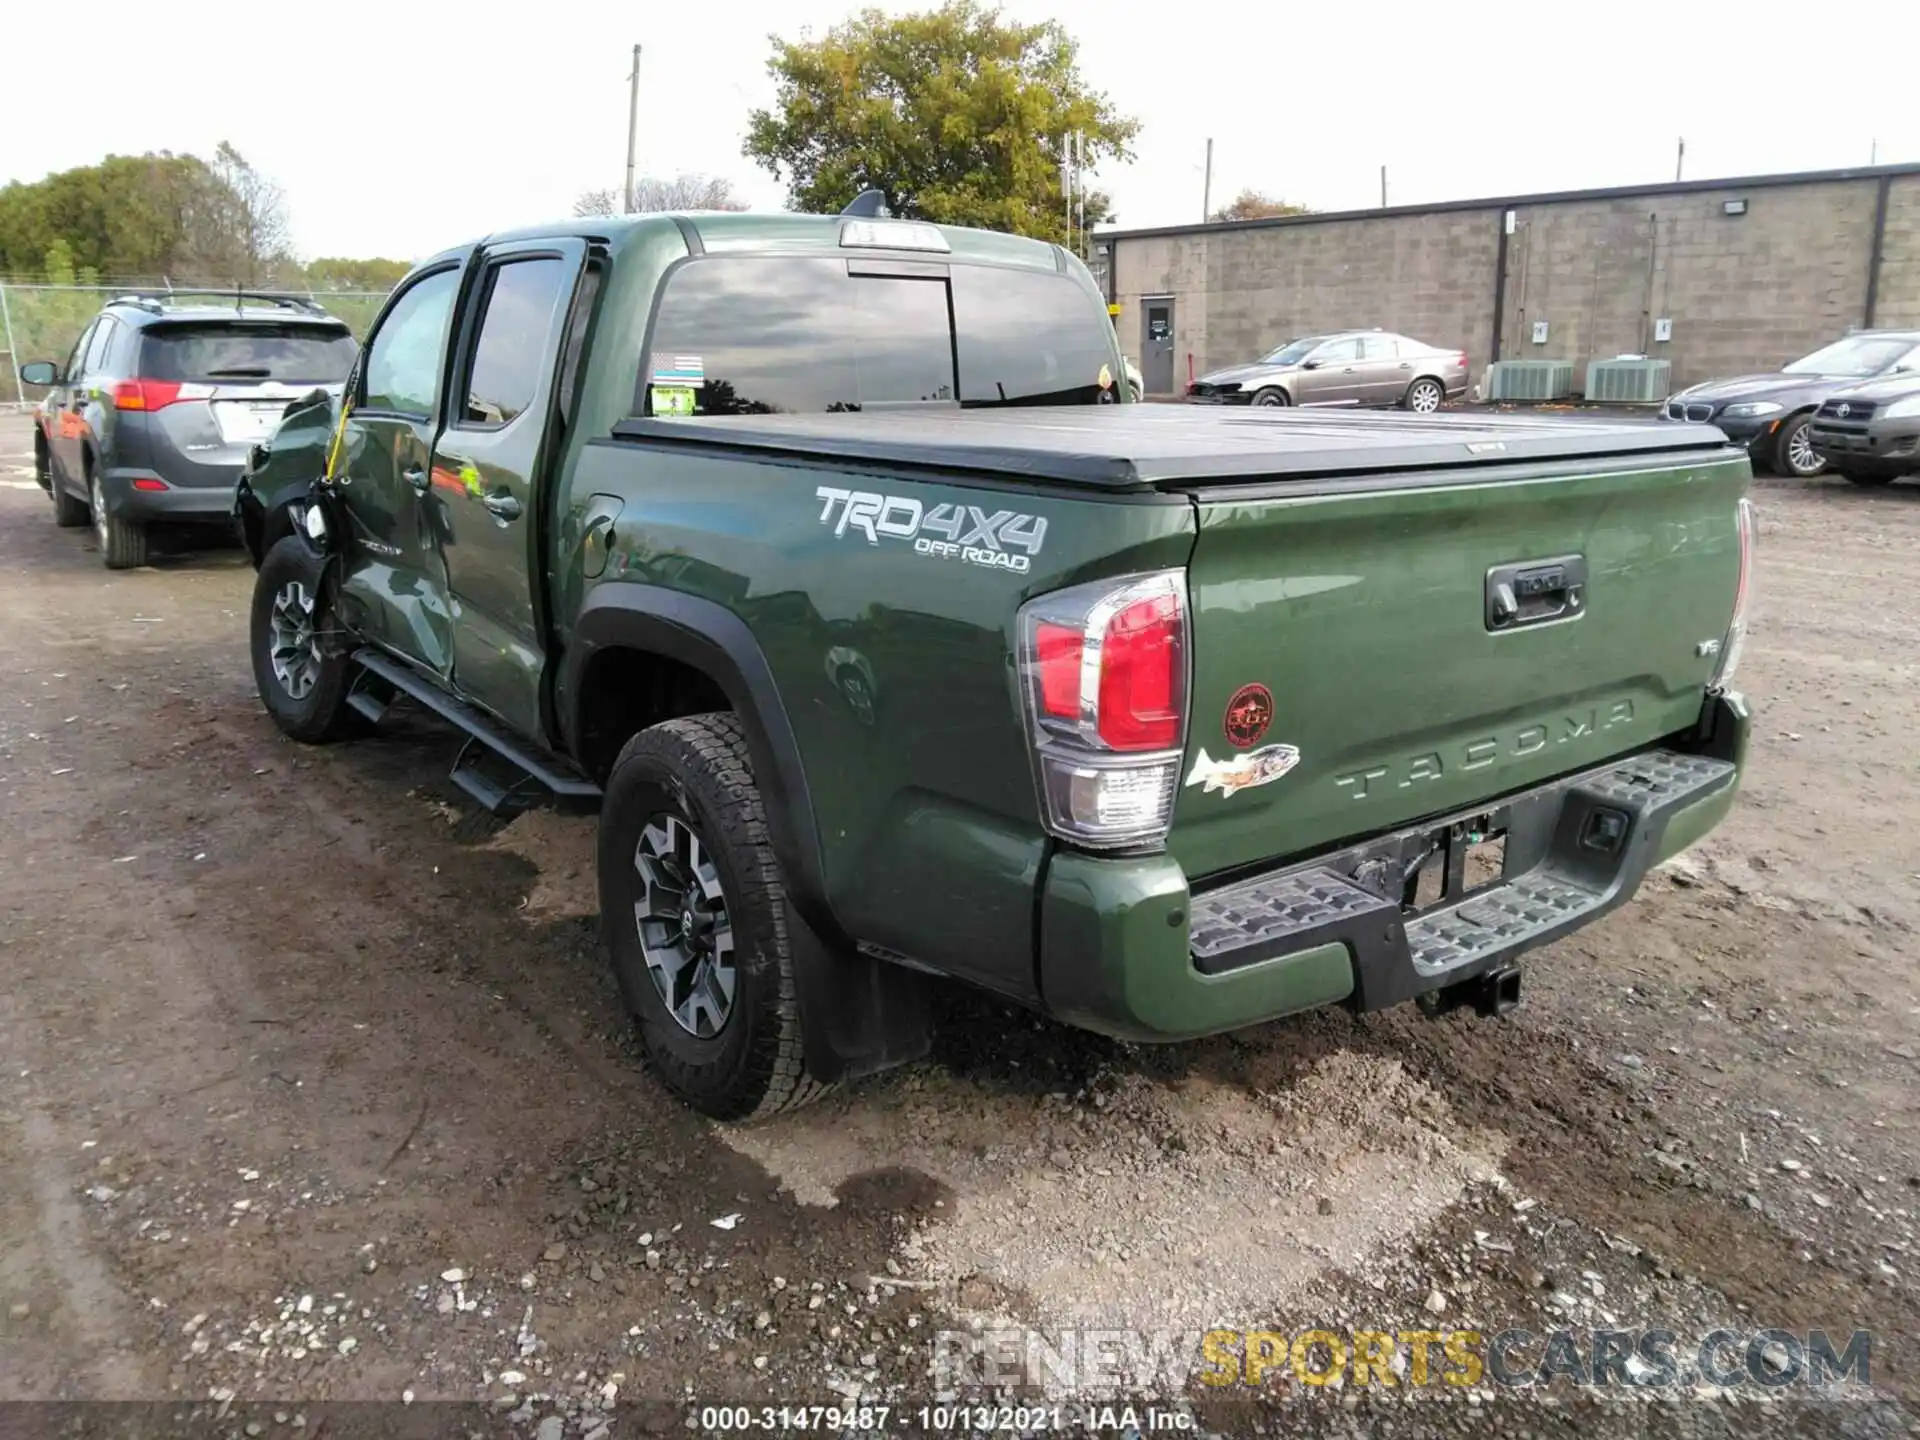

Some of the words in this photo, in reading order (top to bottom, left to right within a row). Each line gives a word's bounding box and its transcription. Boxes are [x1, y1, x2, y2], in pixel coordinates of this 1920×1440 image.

[914, 538, 959, 557] OFF
[961, 547, 1030, 574] ROAD
[1335, 698, 1635, 800] TACOMA
